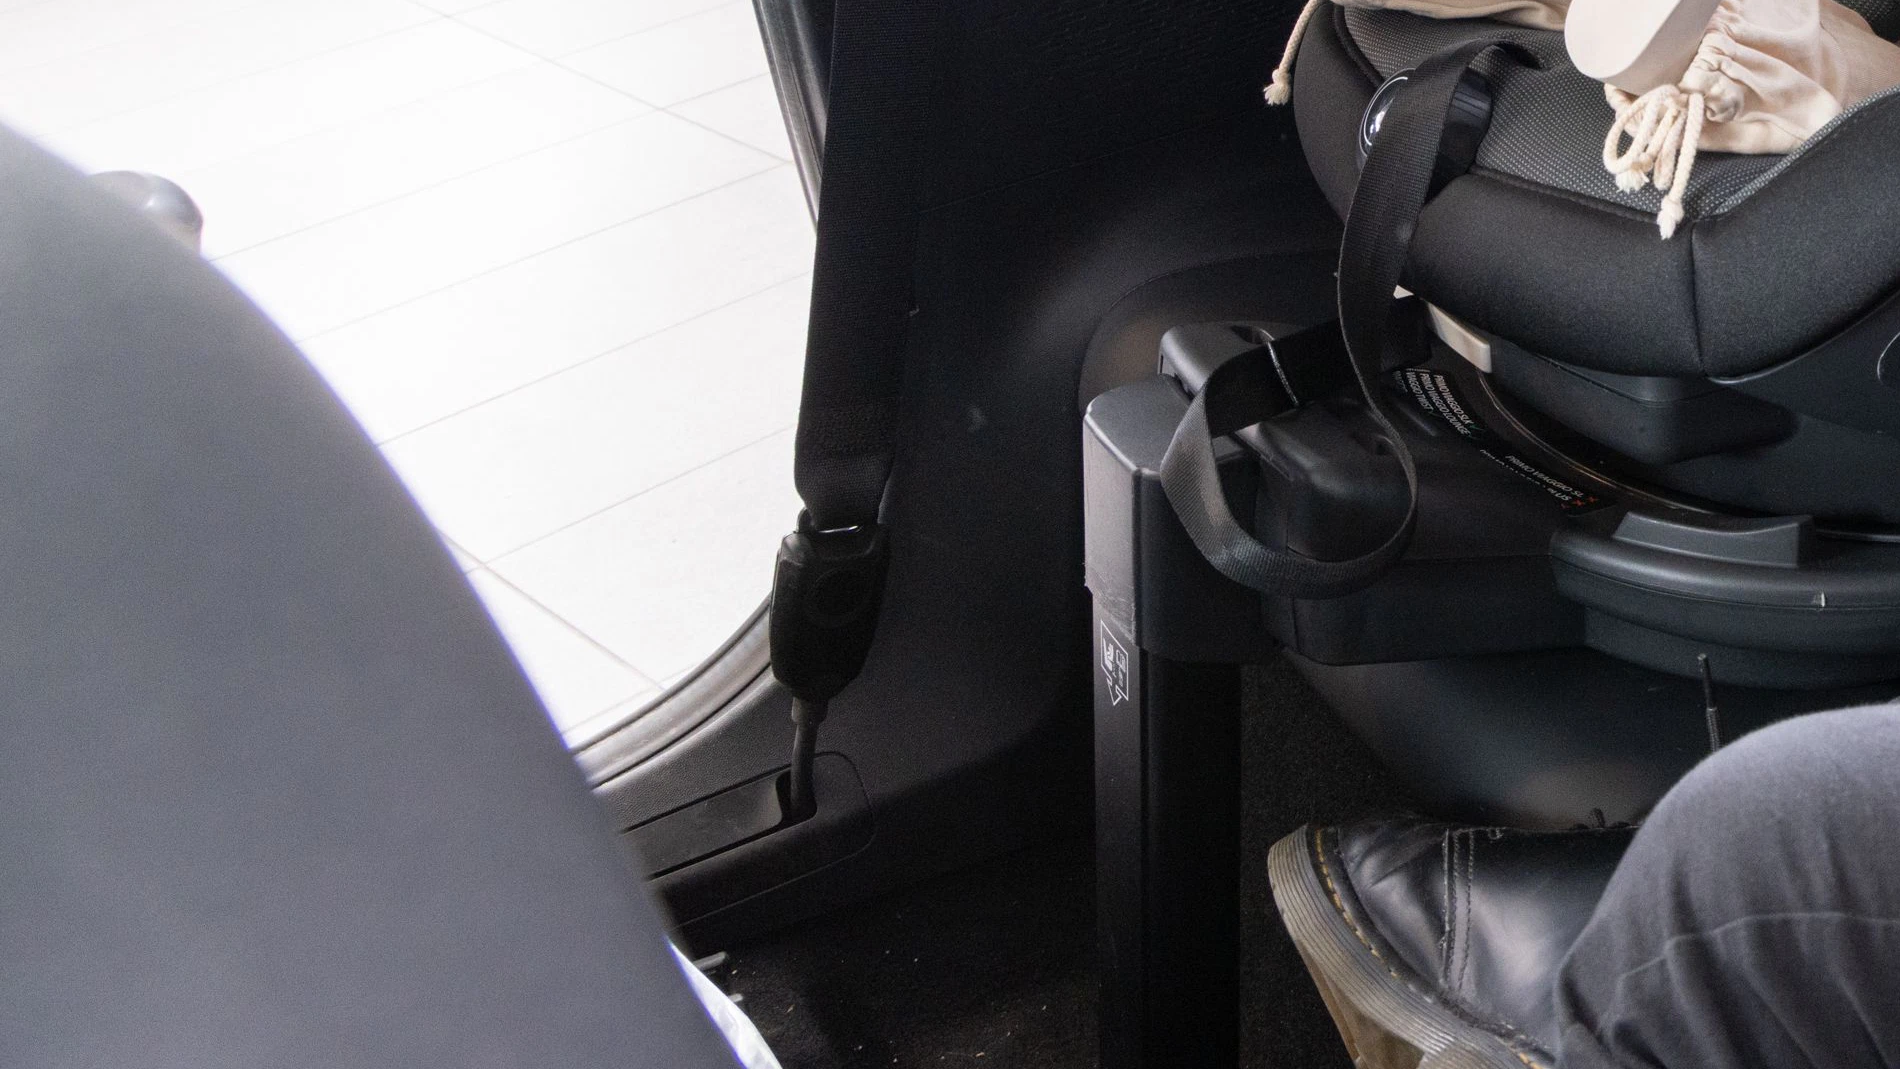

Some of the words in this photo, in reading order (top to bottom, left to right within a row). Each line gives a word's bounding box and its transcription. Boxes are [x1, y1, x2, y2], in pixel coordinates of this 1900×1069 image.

[1419, 373, 1434, 388] PRIMO
[1433, 375, 1449, 391] PRIMO
[1532, 471, 1572, 491] VIAGGIO
